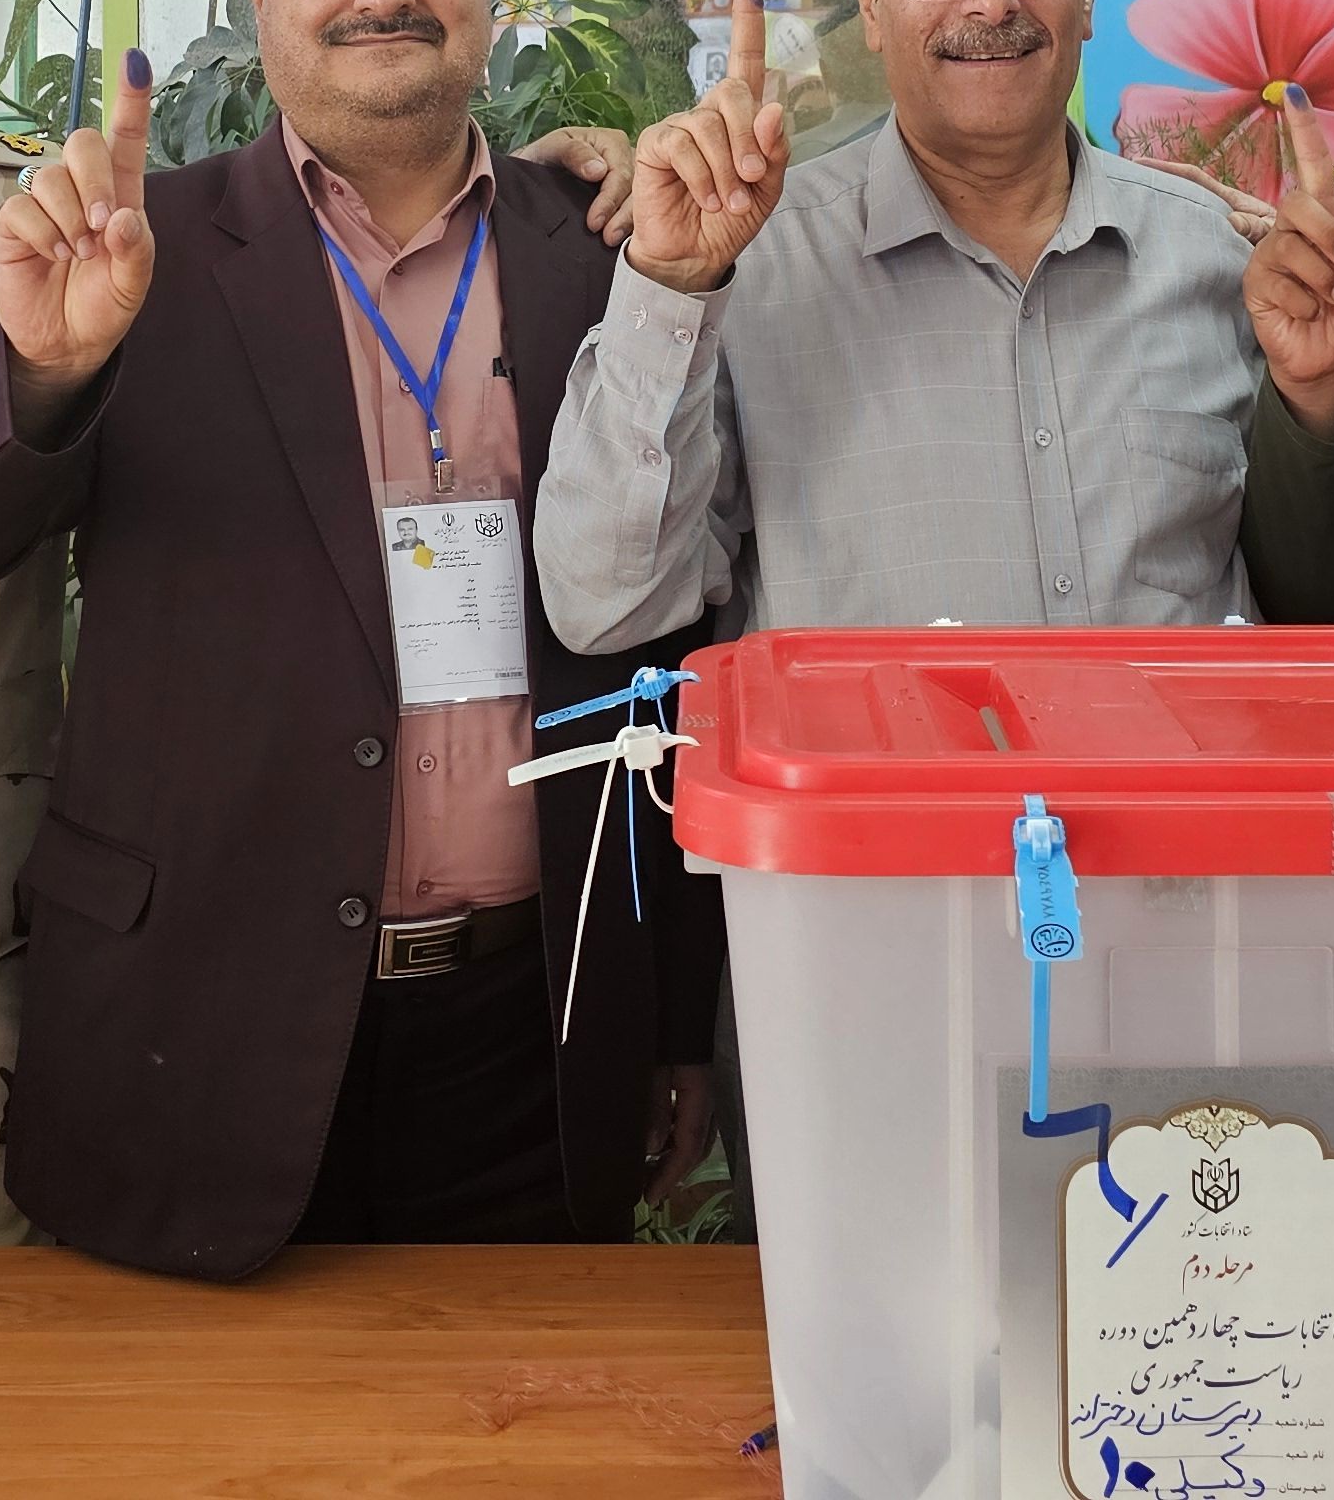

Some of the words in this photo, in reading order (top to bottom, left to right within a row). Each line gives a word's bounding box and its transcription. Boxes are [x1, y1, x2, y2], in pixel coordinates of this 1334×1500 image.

[1181, 1211, 1209, 1239] کشور
[1198, 1221, 1235, 1241] انتخابات
[1238, 1225, 1253, 1237] ستاد
[1182, 1254, 1211, 1296] دوم
[1215, 1254, 1254, 1284] مرحله
[1099, 1326, 1137, 1341] دوره
[1143, 1303, 1240, 1350] چهاردهمین
[1131, 1359, 1204, 1395] جمهوری
[1203, 1363, 1302, 1400] ریاست
[1135, 1397, 1263, 1439] دبیرستان
[1275, 1418, 1298, 1428] شعبه
[1299, 1418, 1325, 1430] شماره
[1285, 1451, 1309, 1460] شعبه
[1311, 1451, 1325, 1461] نام
[1278, 1483, 1327, 1494] شهرستان
